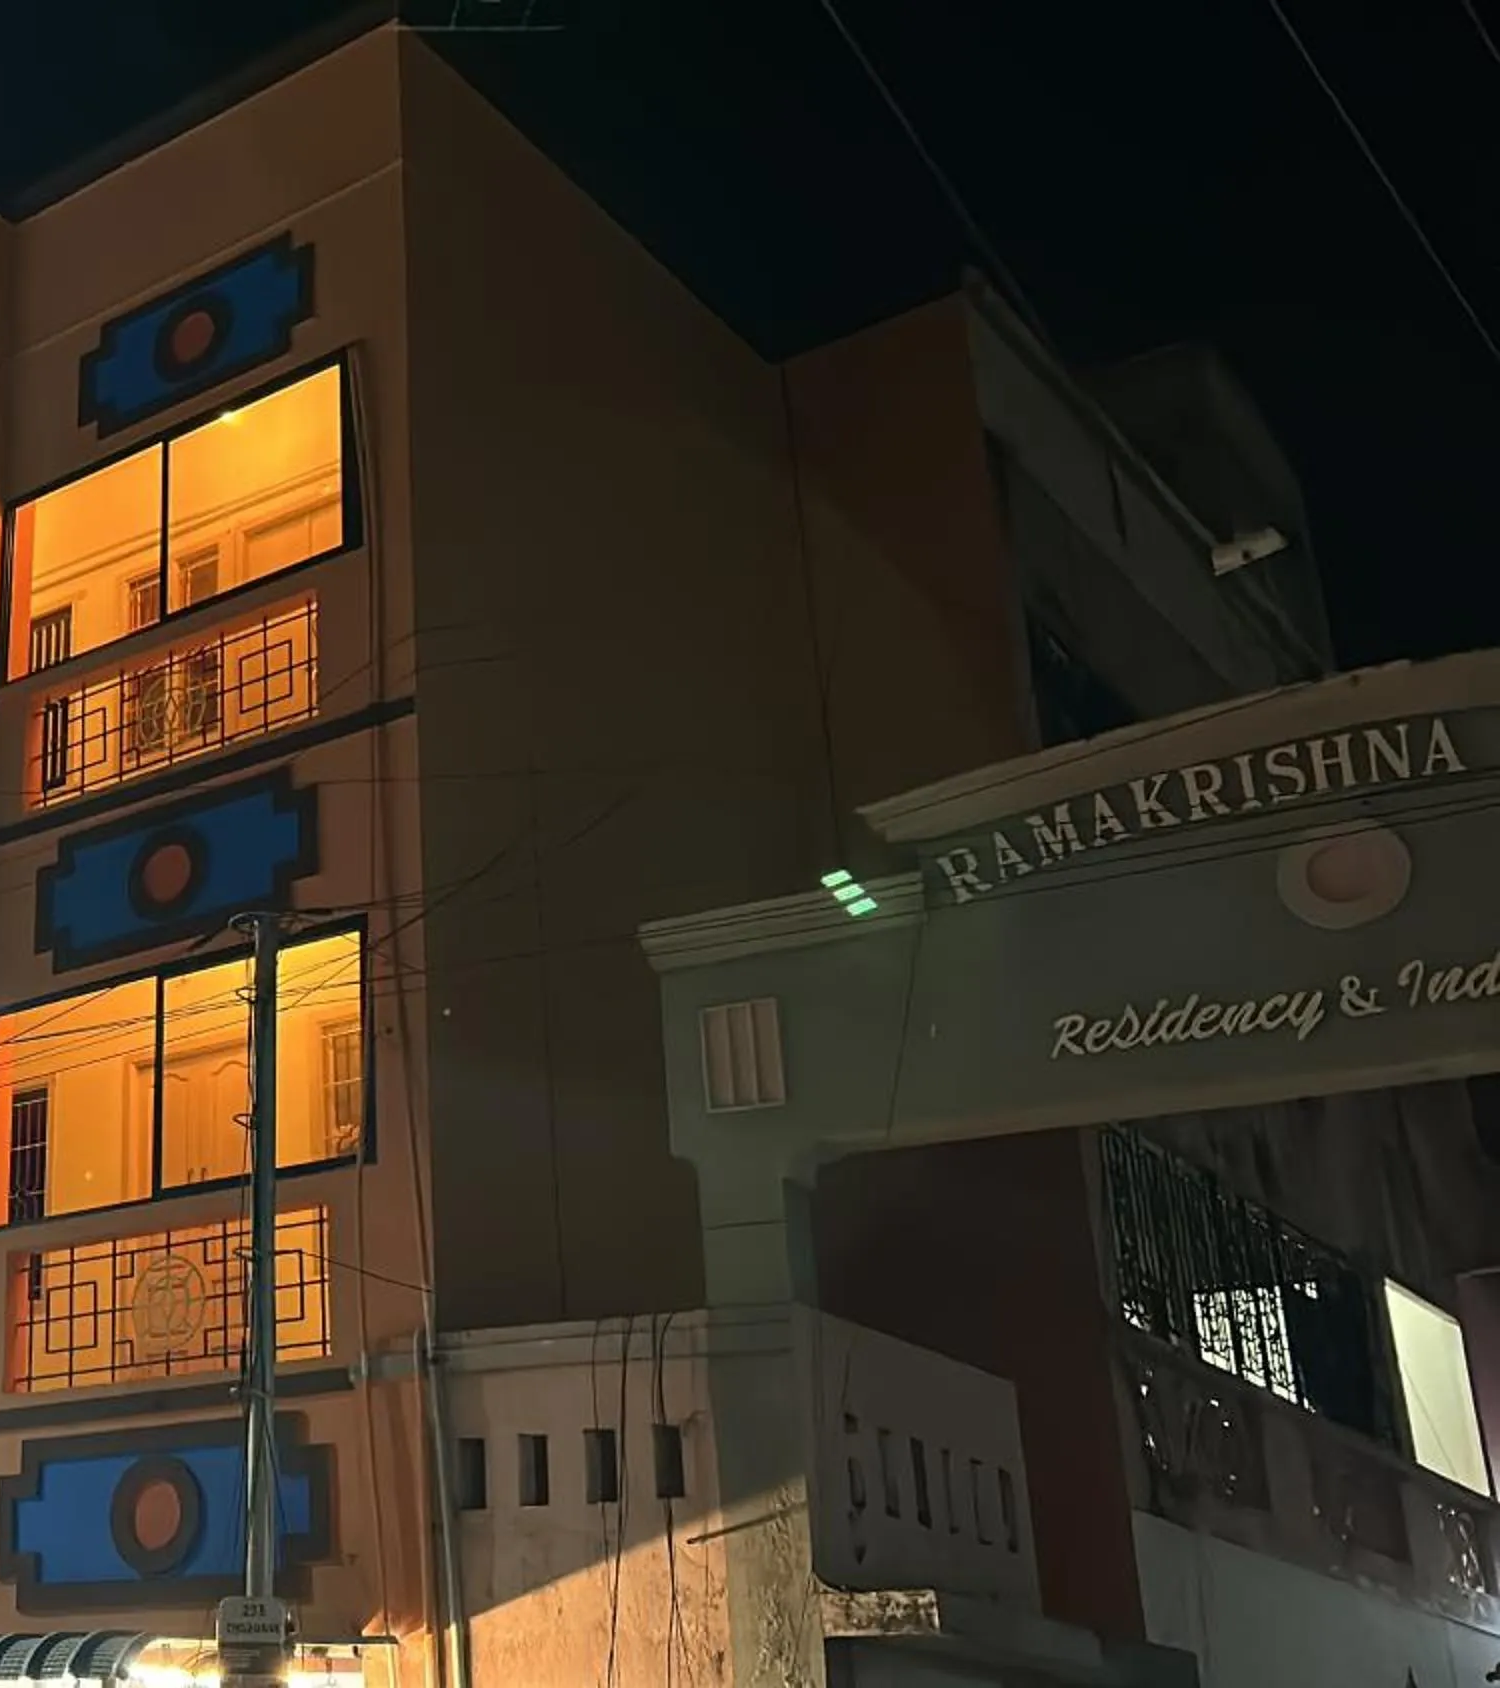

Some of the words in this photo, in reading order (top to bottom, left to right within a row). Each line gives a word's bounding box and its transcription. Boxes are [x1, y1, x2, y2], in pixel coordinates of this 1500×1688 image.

[936, 718, 1467, 903] RAMAKRISHNA
[1051, 993, 1325, 1058] Residency
[1339, 975, 1388, 1018] &
